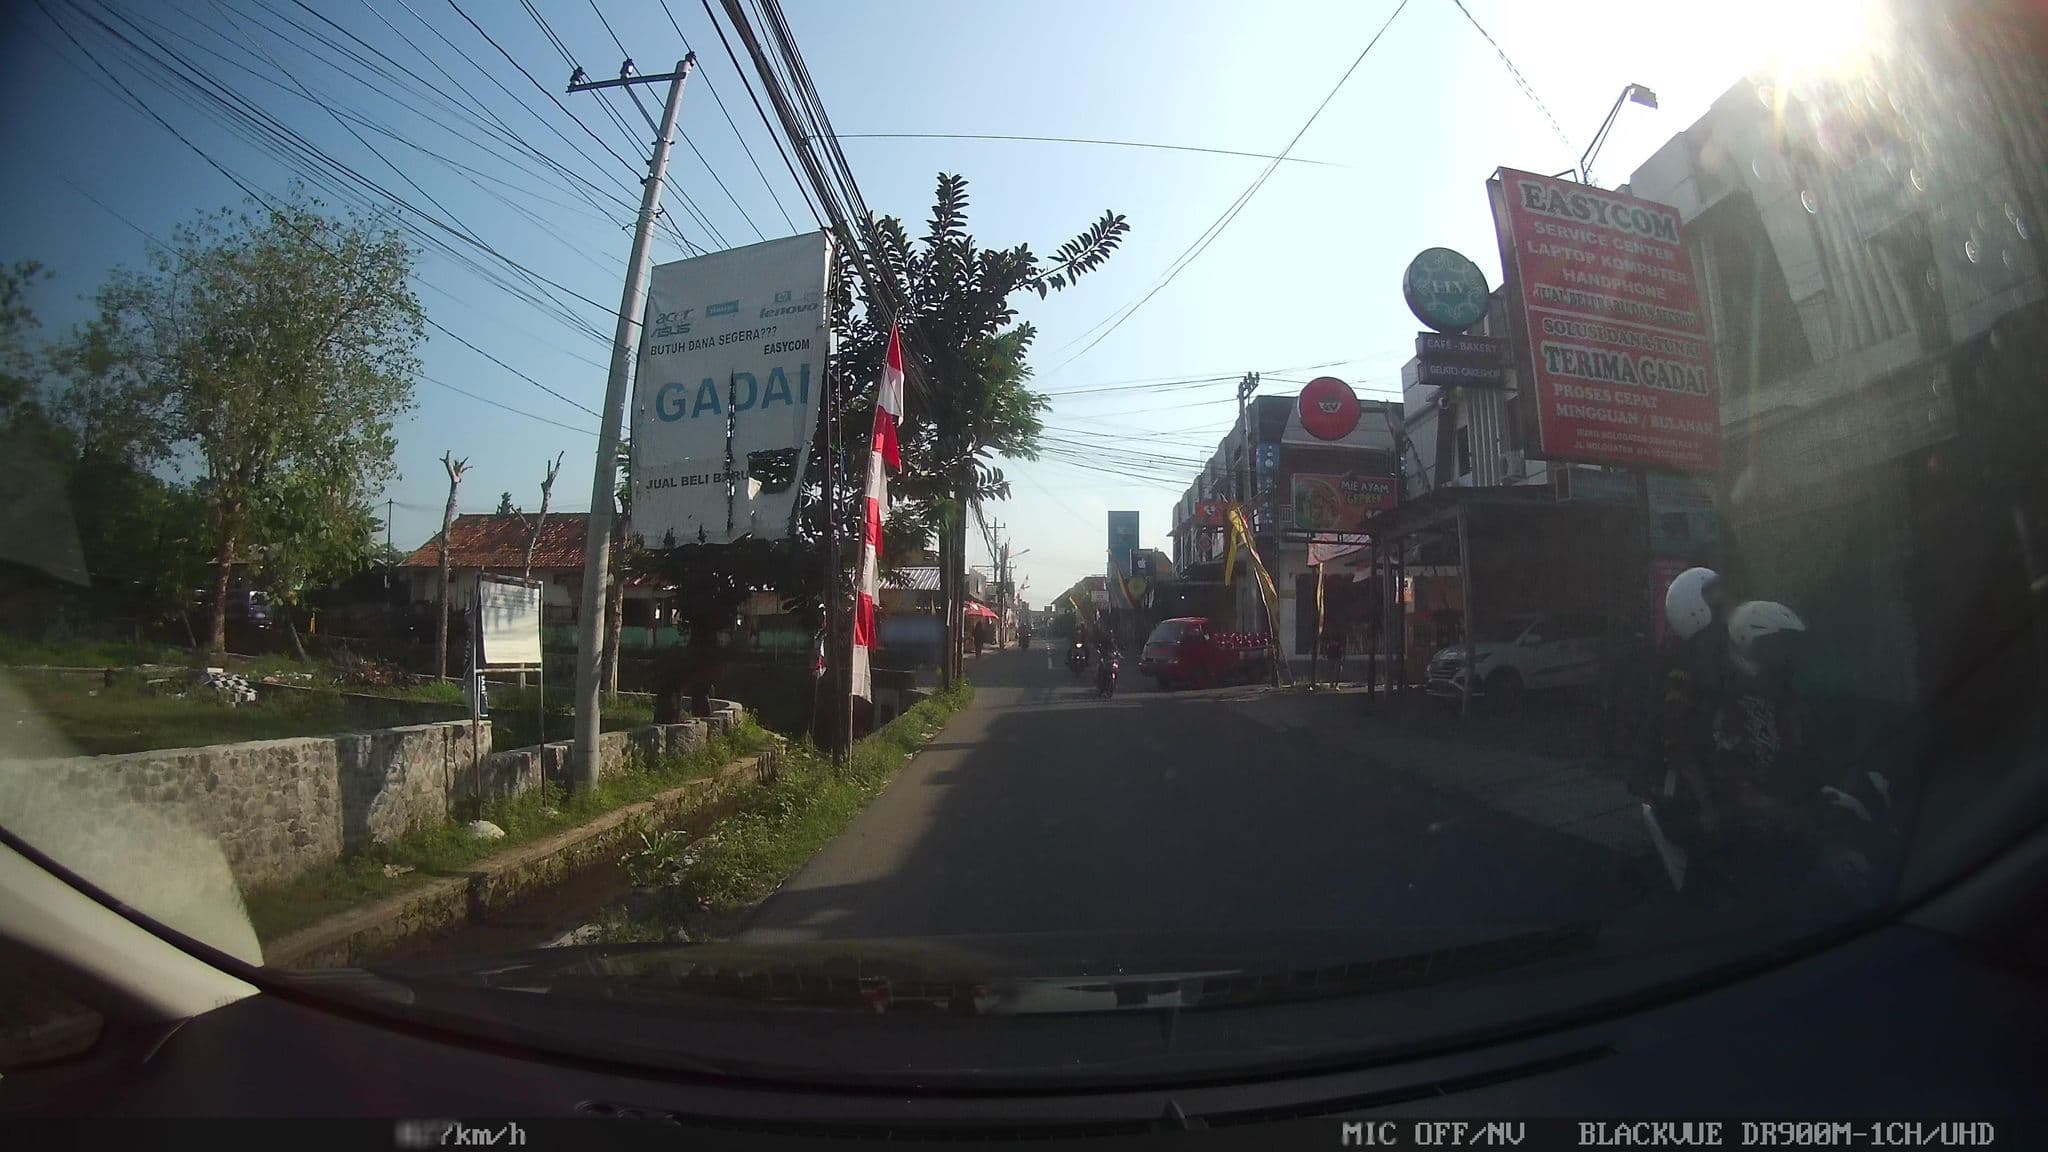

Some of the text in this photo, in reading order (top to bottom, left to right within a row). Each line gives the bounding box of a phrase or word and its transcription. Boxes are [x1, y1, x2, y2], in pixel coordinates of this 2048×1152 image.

[1519, 179, 1680, 245] EASYCOM
[1534, 221, 1675, 261] SERVICE CENTER
[1527, 239, 1689, 285] LAPTOP KOMPUTER
[1563, 268, 1666, 300] HANDPHONE
[650, 325, 777, 356] BUTUH DANA SEGERA???
[763, 338, 810, 355] EASYCOM
[1542, 340, 1709, 397] TERIMA GADAI
[656, 364, 810, 422] GADAI
[1554, 383, 1612, 402] PROSES
[1556, 402, 1638, 426] MINGGUAN
[646, 474, 678, 490] JUAL
[681, 474, 709, 487] BELI
[1341, 480, 1389, 494] MIE AYAM
